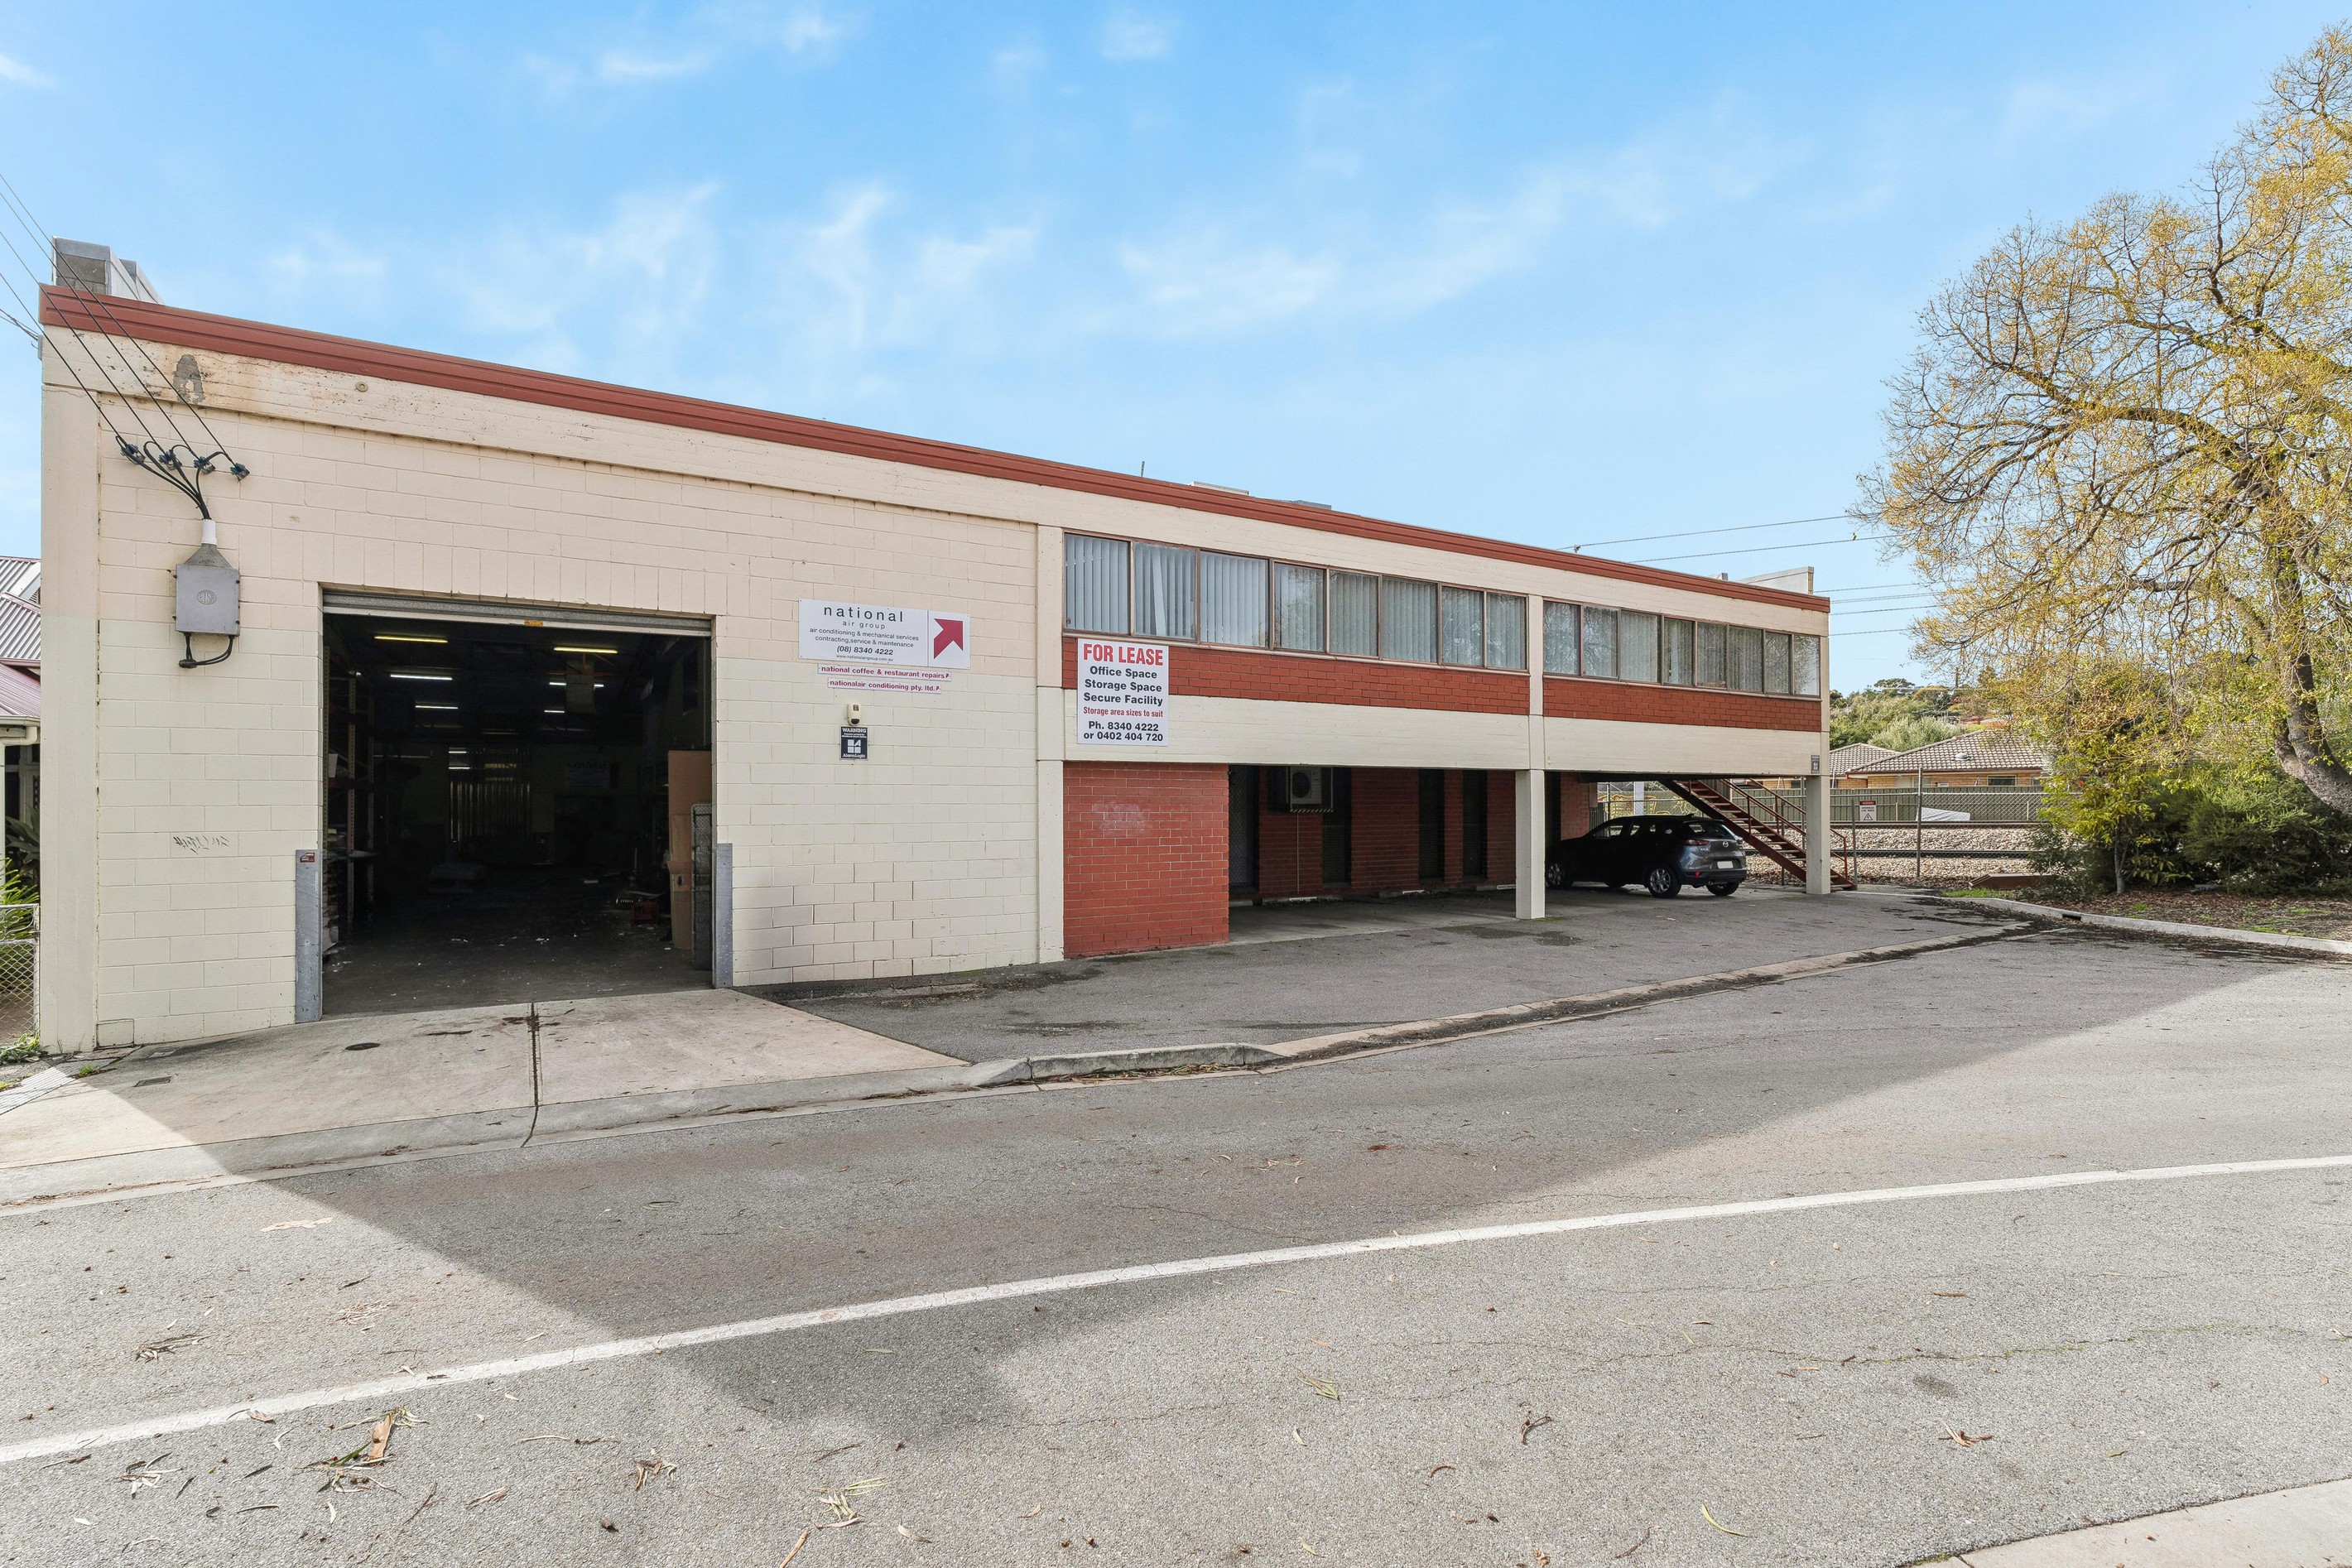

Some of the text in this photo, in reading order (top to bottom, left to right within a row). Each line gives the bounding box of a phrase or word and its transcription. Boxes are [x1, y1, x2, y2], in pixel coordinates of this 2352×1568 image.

[824, 607, 902, 622] national
[819, 628, 855, 637] conditioning
[1084, 643, 1163, 666] FOR LEASE
[821, 665, 850, 673] national
[1089, 666, 1157, 679] Office Space
[1085, 679, 1162, 693] Storage Space
[1084, 692, 1163, 707] Secure Facility
[1084, 707, 1109, 716] Storage
[1126, 709, 1142, 717] sizes
[1089, 721, 1159, 732] Ph. 8340 4222
[1097, 732, 1122, 740] 0402
[1125, 733, 1142, 741] 404
[1146, 733, 1163, 742] 720
